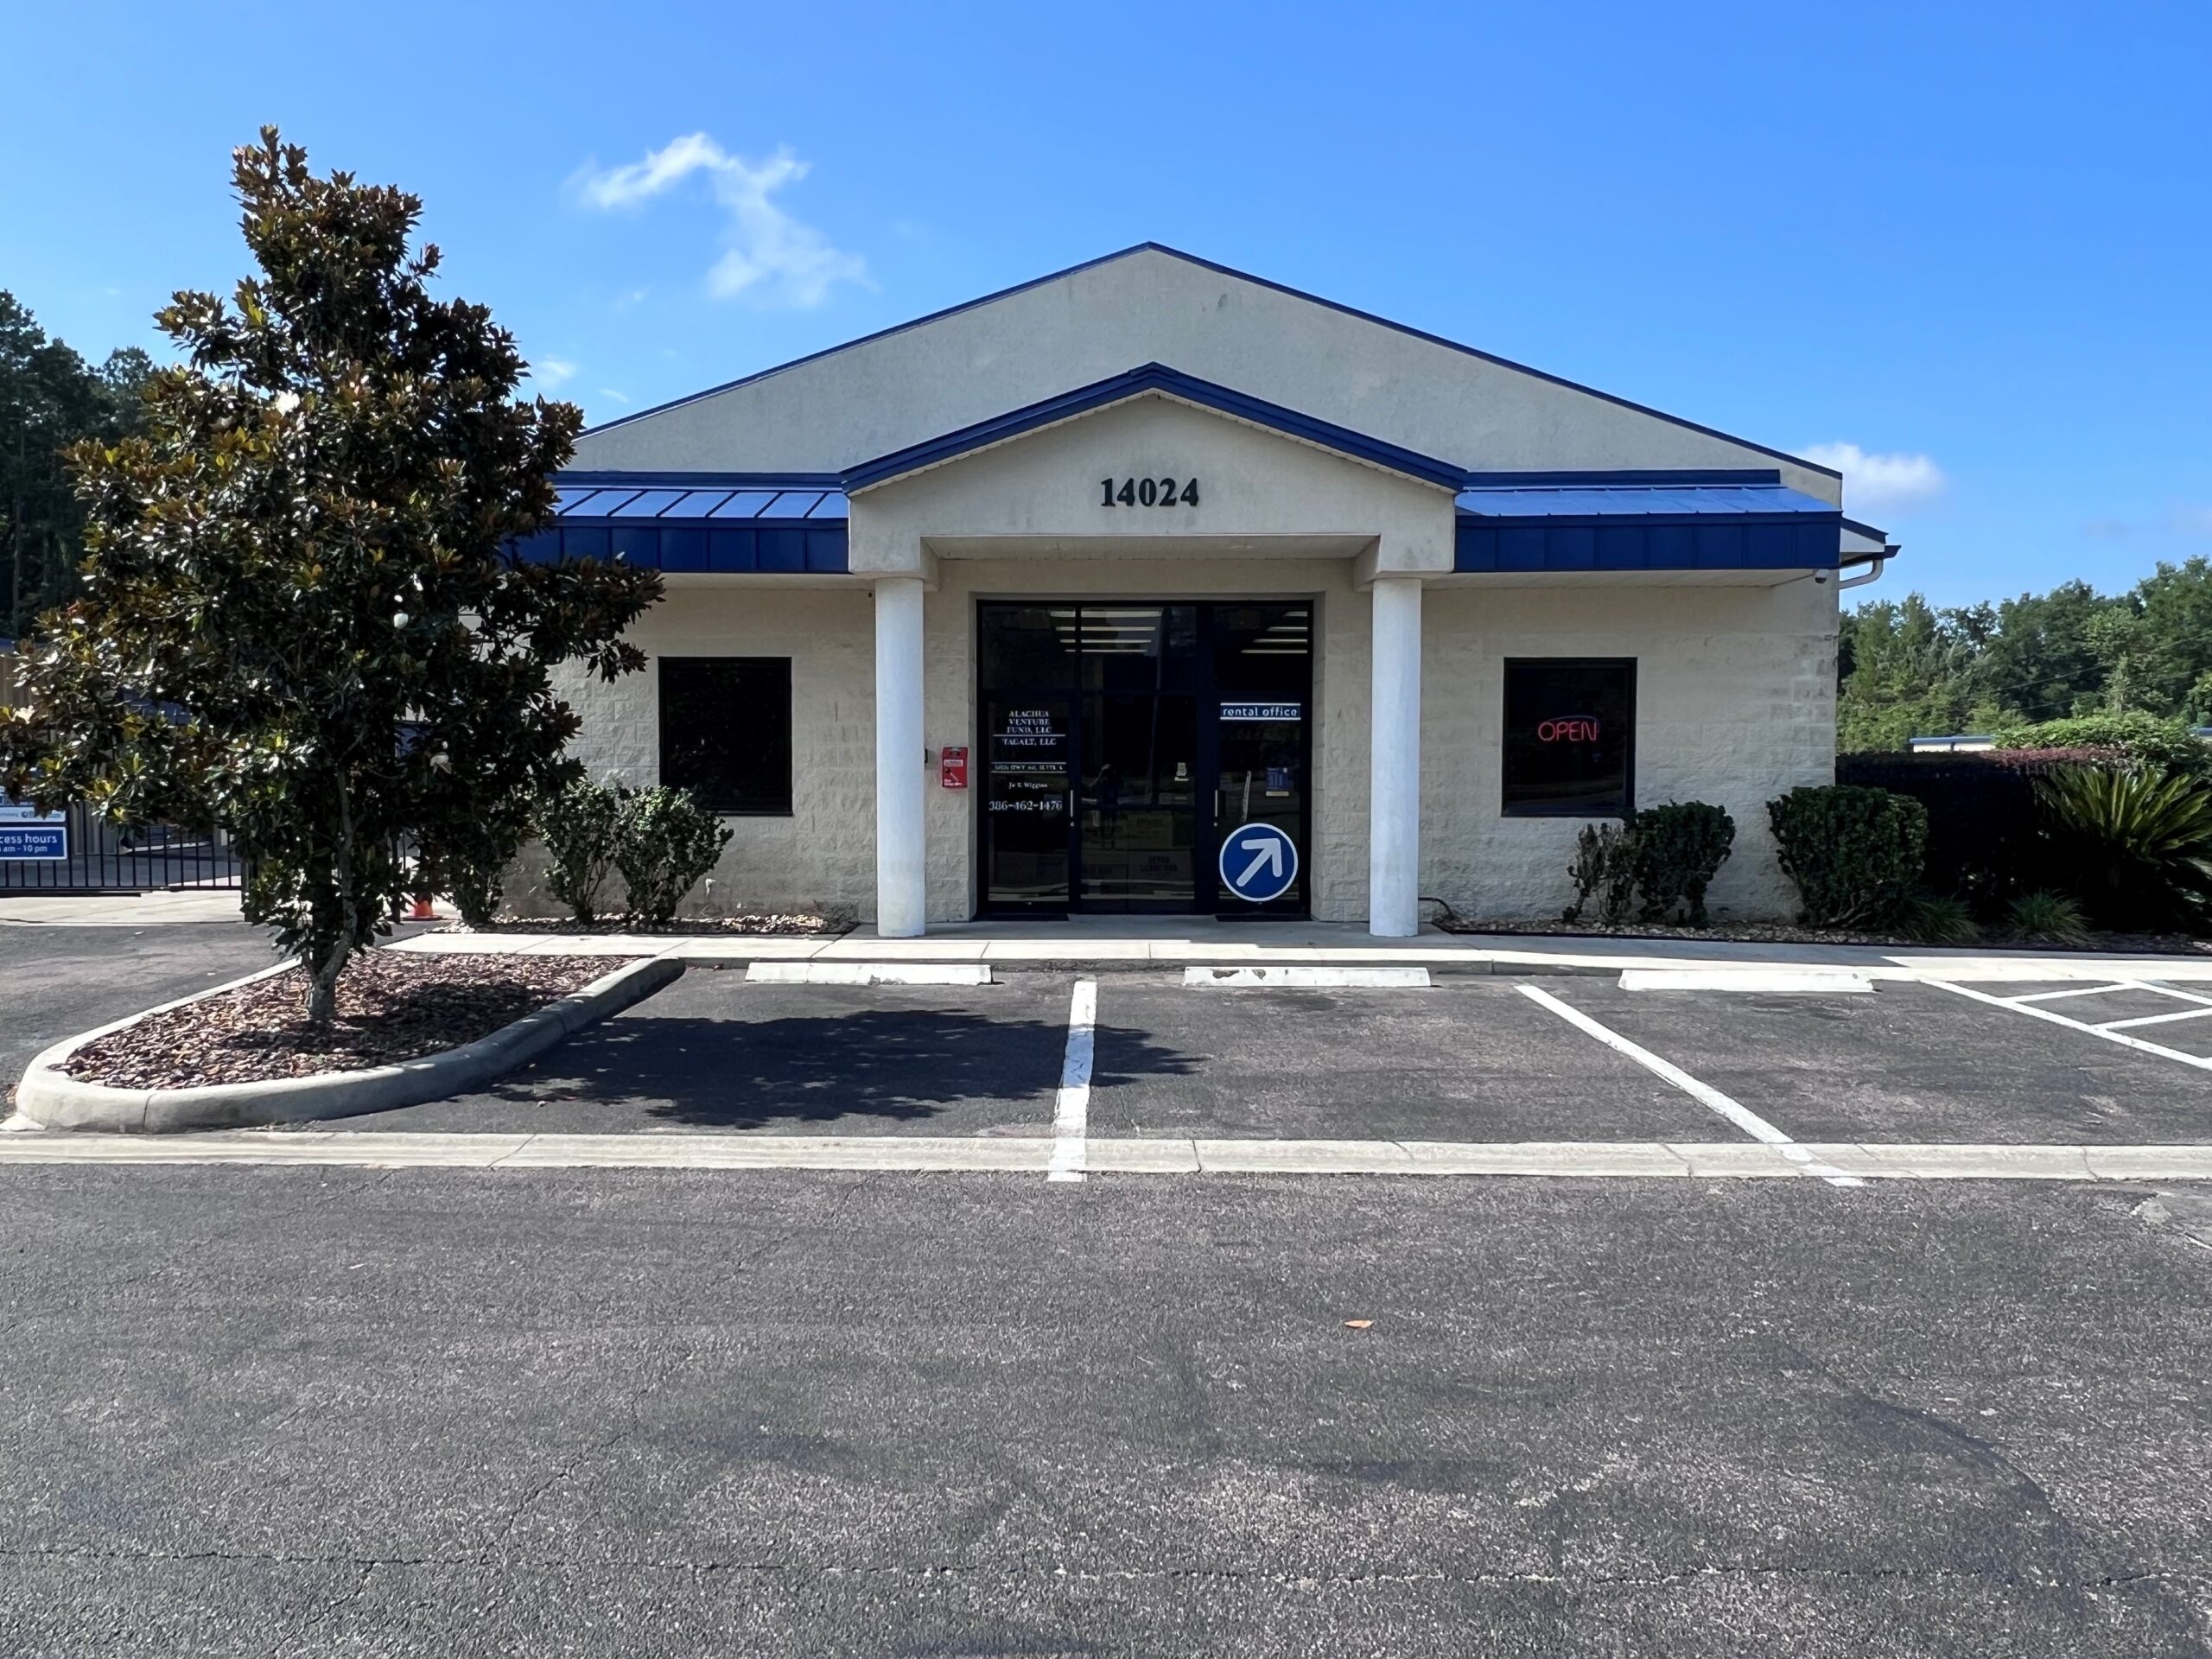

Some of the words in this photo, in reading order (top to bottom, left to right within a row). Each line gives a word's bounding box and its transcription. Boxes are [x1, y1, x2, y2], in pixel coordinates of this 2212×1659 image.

[1101, 478, 1199, 507] 14024
[1223, 707, 1258, 716] rental
[1262, 706, 1298, 716] office
[1538, 721, 1598, 741] OPEN
[988, 800, 1063, 811] 386-462-1476
[25, 833, 58, 843] hours
